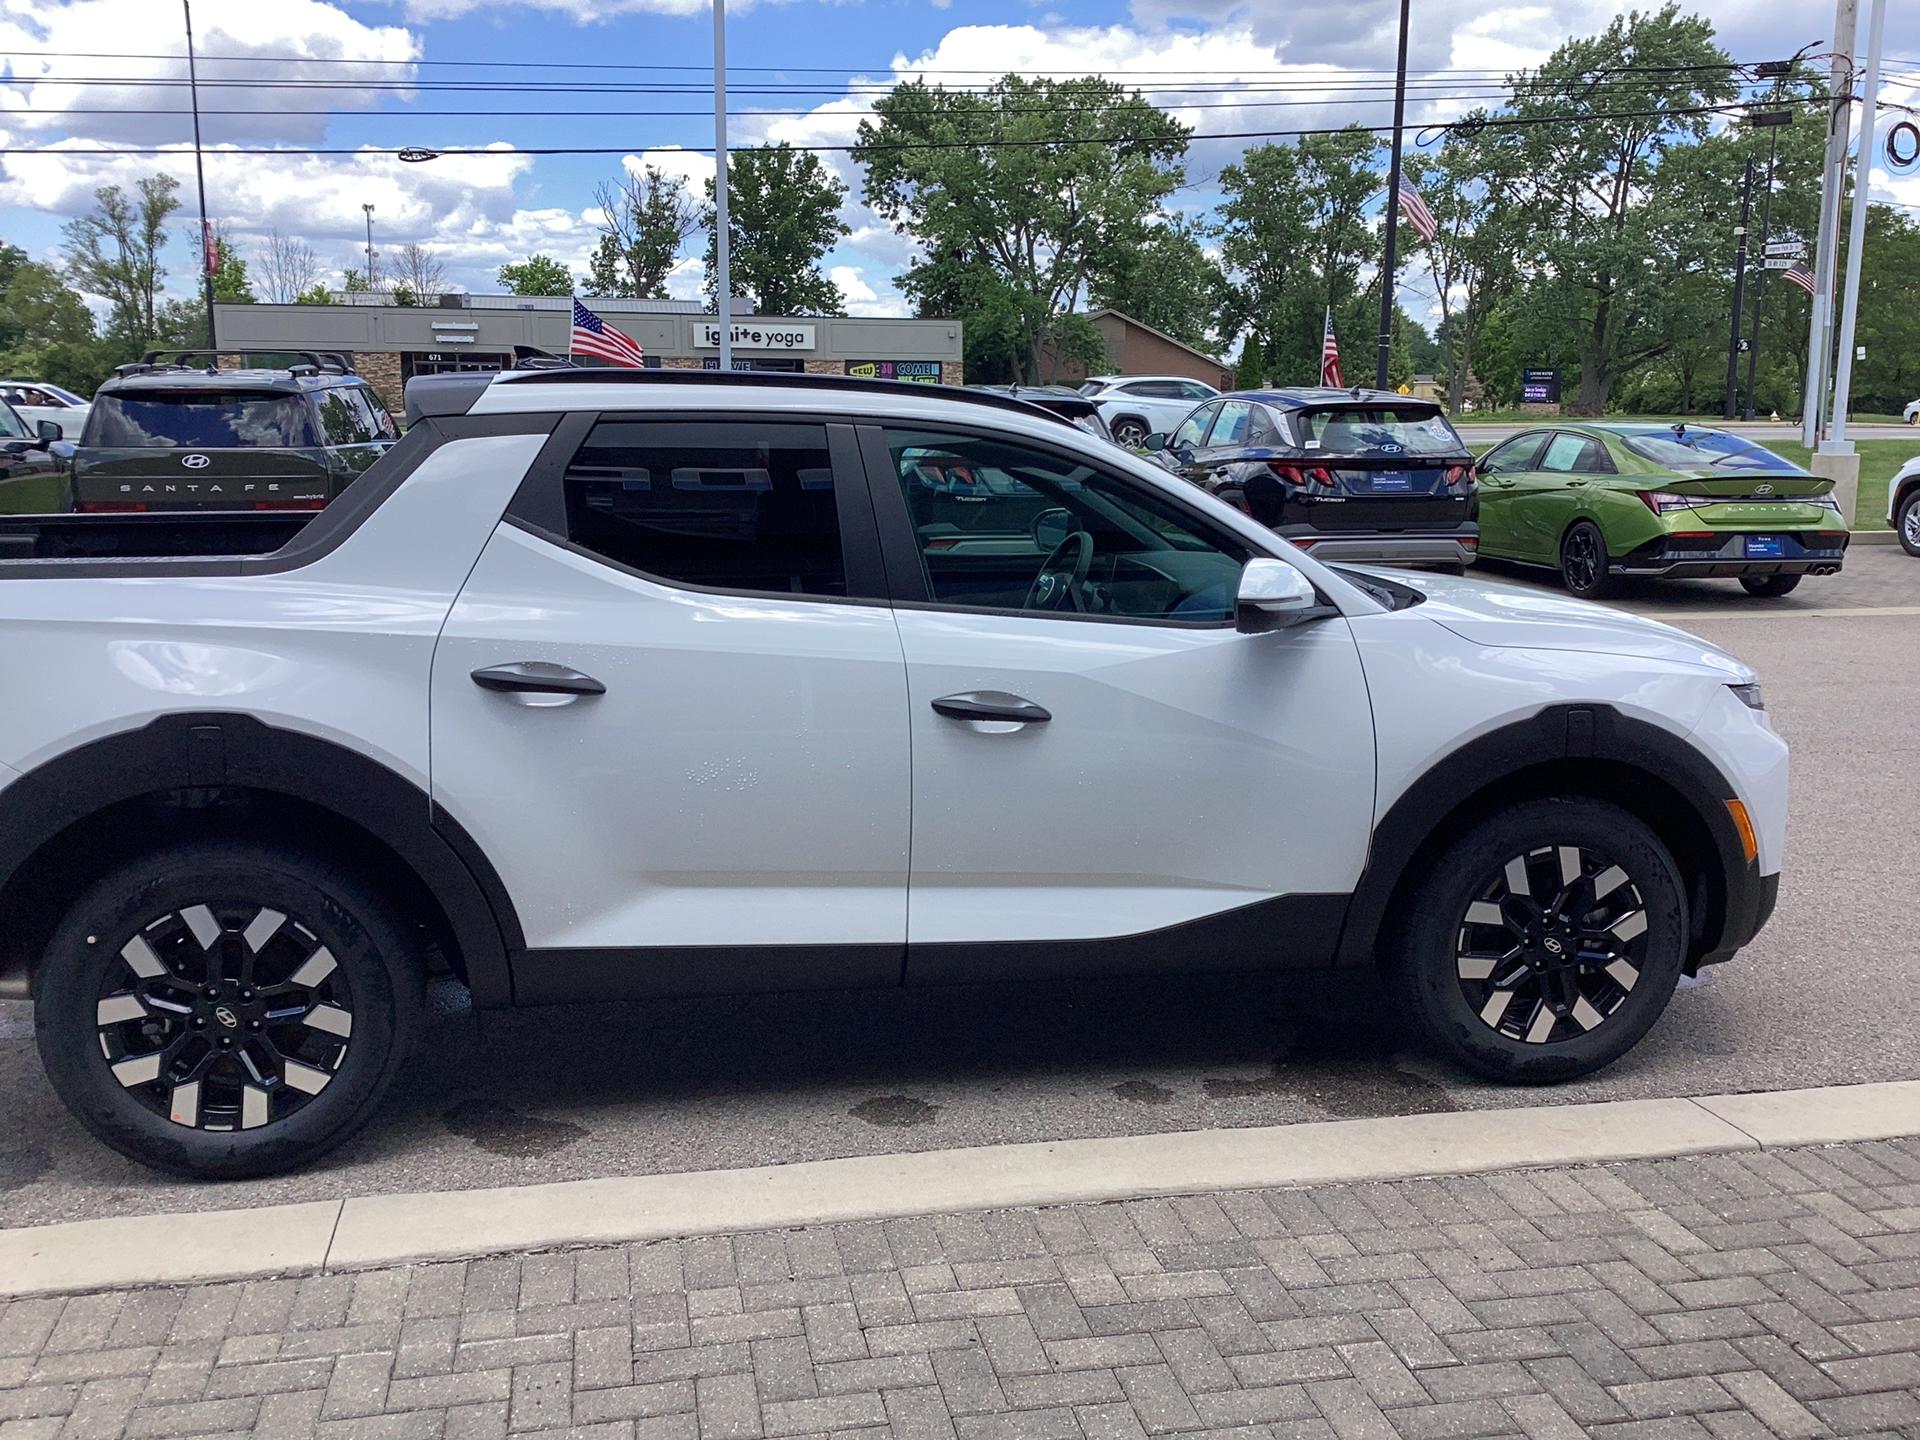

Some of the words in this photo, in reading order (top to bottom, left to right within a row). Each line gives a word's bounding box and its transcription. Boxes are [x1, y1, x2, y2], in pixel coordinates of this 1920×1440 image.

[705, 326, 762, 346] igite
[766, 332, 804, 347] yoga
[705, 361, 750, 371] HVE
[897, 362, 930, 375] COME
[244, 483, 280, 491] FE
